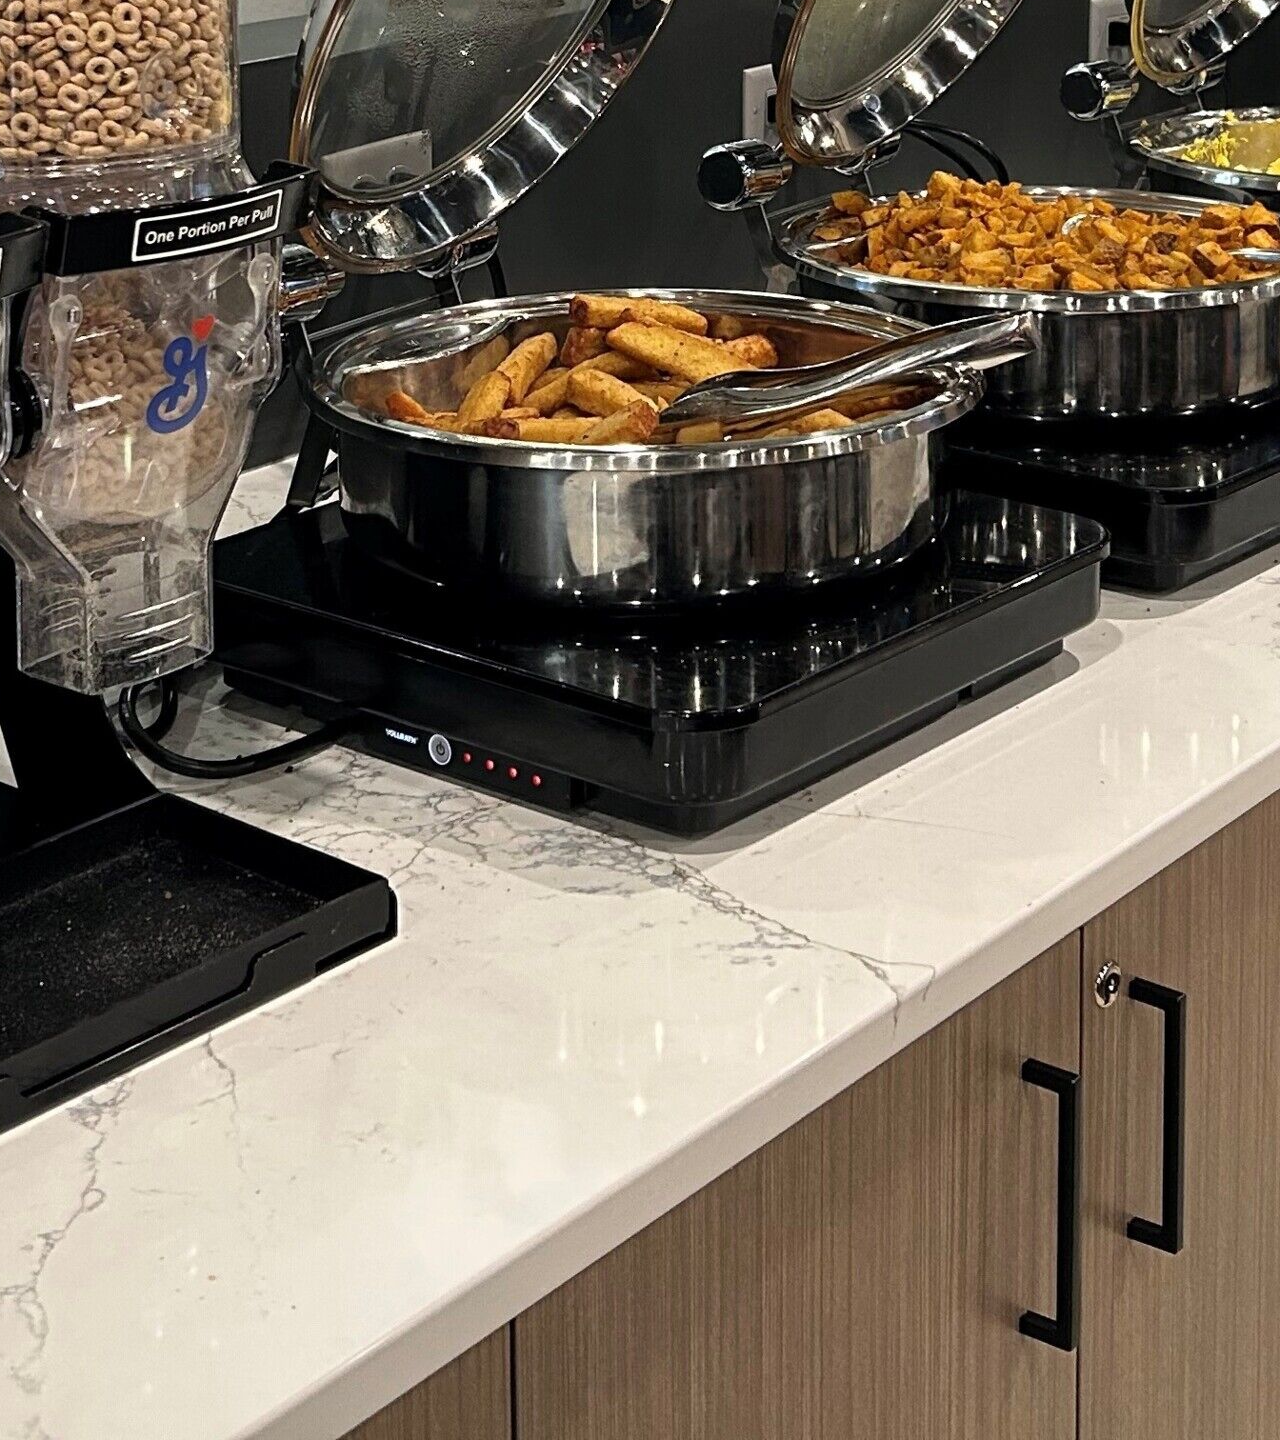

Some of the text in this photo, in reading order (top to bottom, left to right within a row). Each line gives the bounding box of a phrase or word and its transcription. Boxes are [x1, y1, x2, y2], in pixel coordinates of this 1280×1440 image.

[145, 205, 274, 245] One Portion Per Pull
